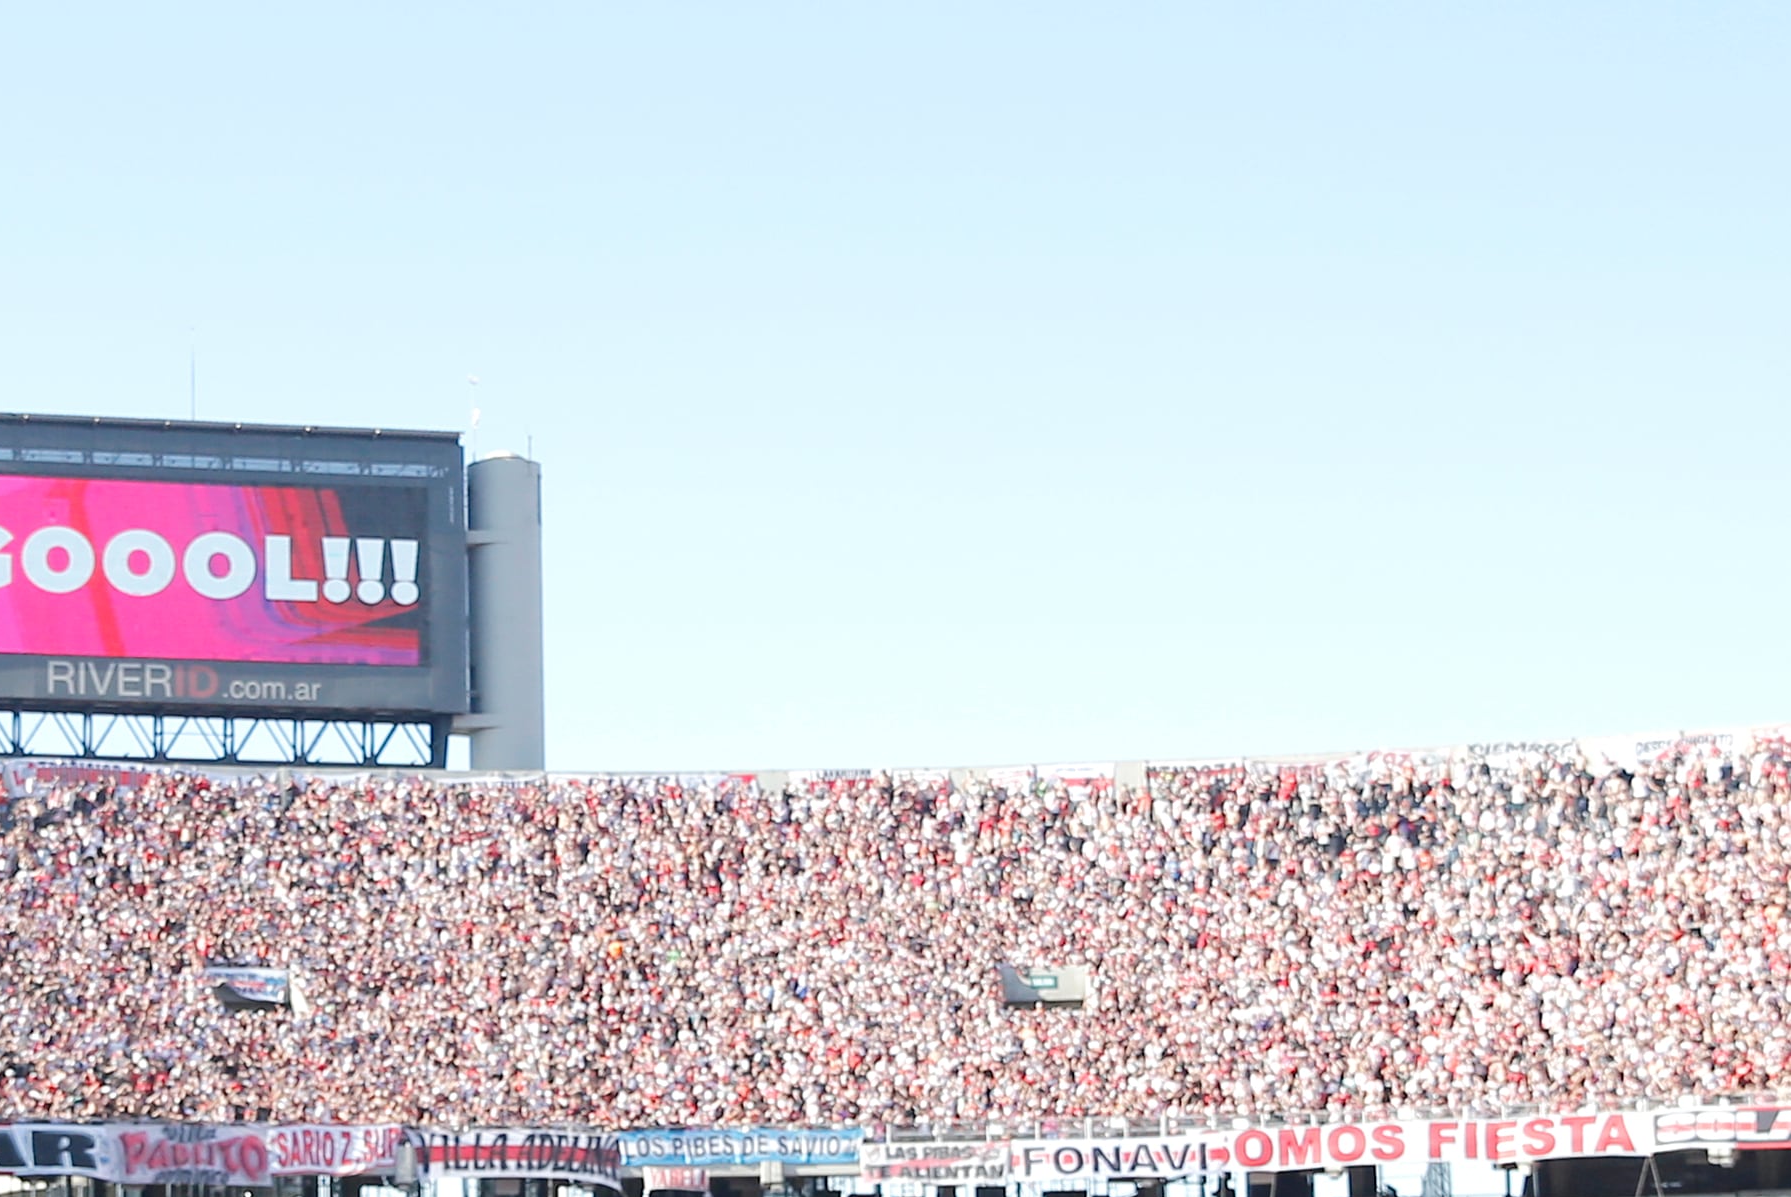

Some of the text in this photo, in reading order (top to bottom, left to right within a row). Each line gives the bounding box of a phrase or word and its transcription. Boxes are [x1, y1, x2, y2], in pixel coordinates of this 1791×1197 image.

[270, 1129, 335, 1168] SARIO
[621, 1135, 840, 1160] LOS PIBES DE SAVIO
[1429, 1114, 1635, 1160] FIESTA
[886, 1146, 917, 1160] LAS
[1023, 1141, 1208, 1177] FONAVI
[900, 1164, 1004, 1180] ALIENTAN
